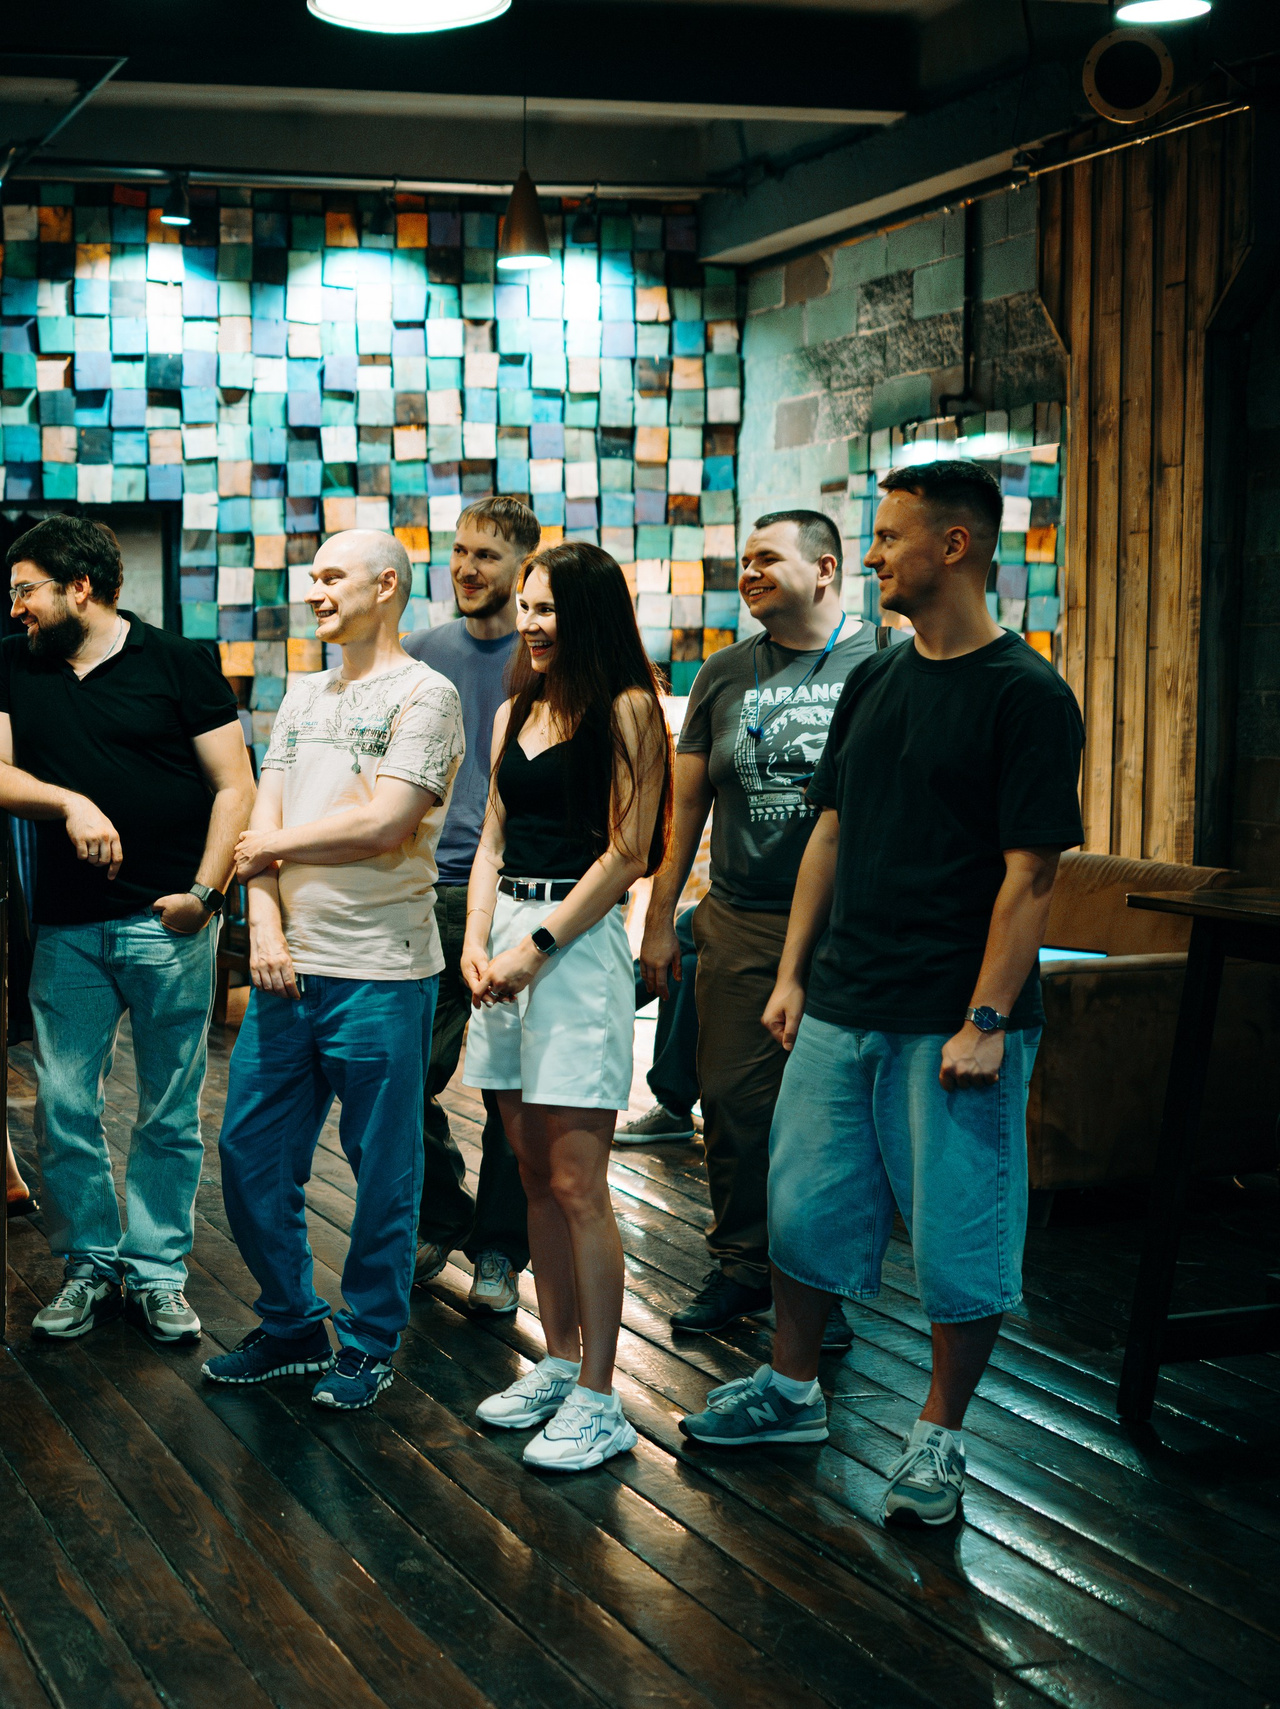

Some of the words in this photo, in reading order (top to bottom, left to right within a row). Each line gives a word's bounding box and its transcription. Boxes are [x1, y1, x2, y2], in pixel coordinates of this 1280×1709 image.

[750, 812, 793, 822] STREET
[799, 810, 820, 818] WE
[747, 1402, 778, 1427] N
